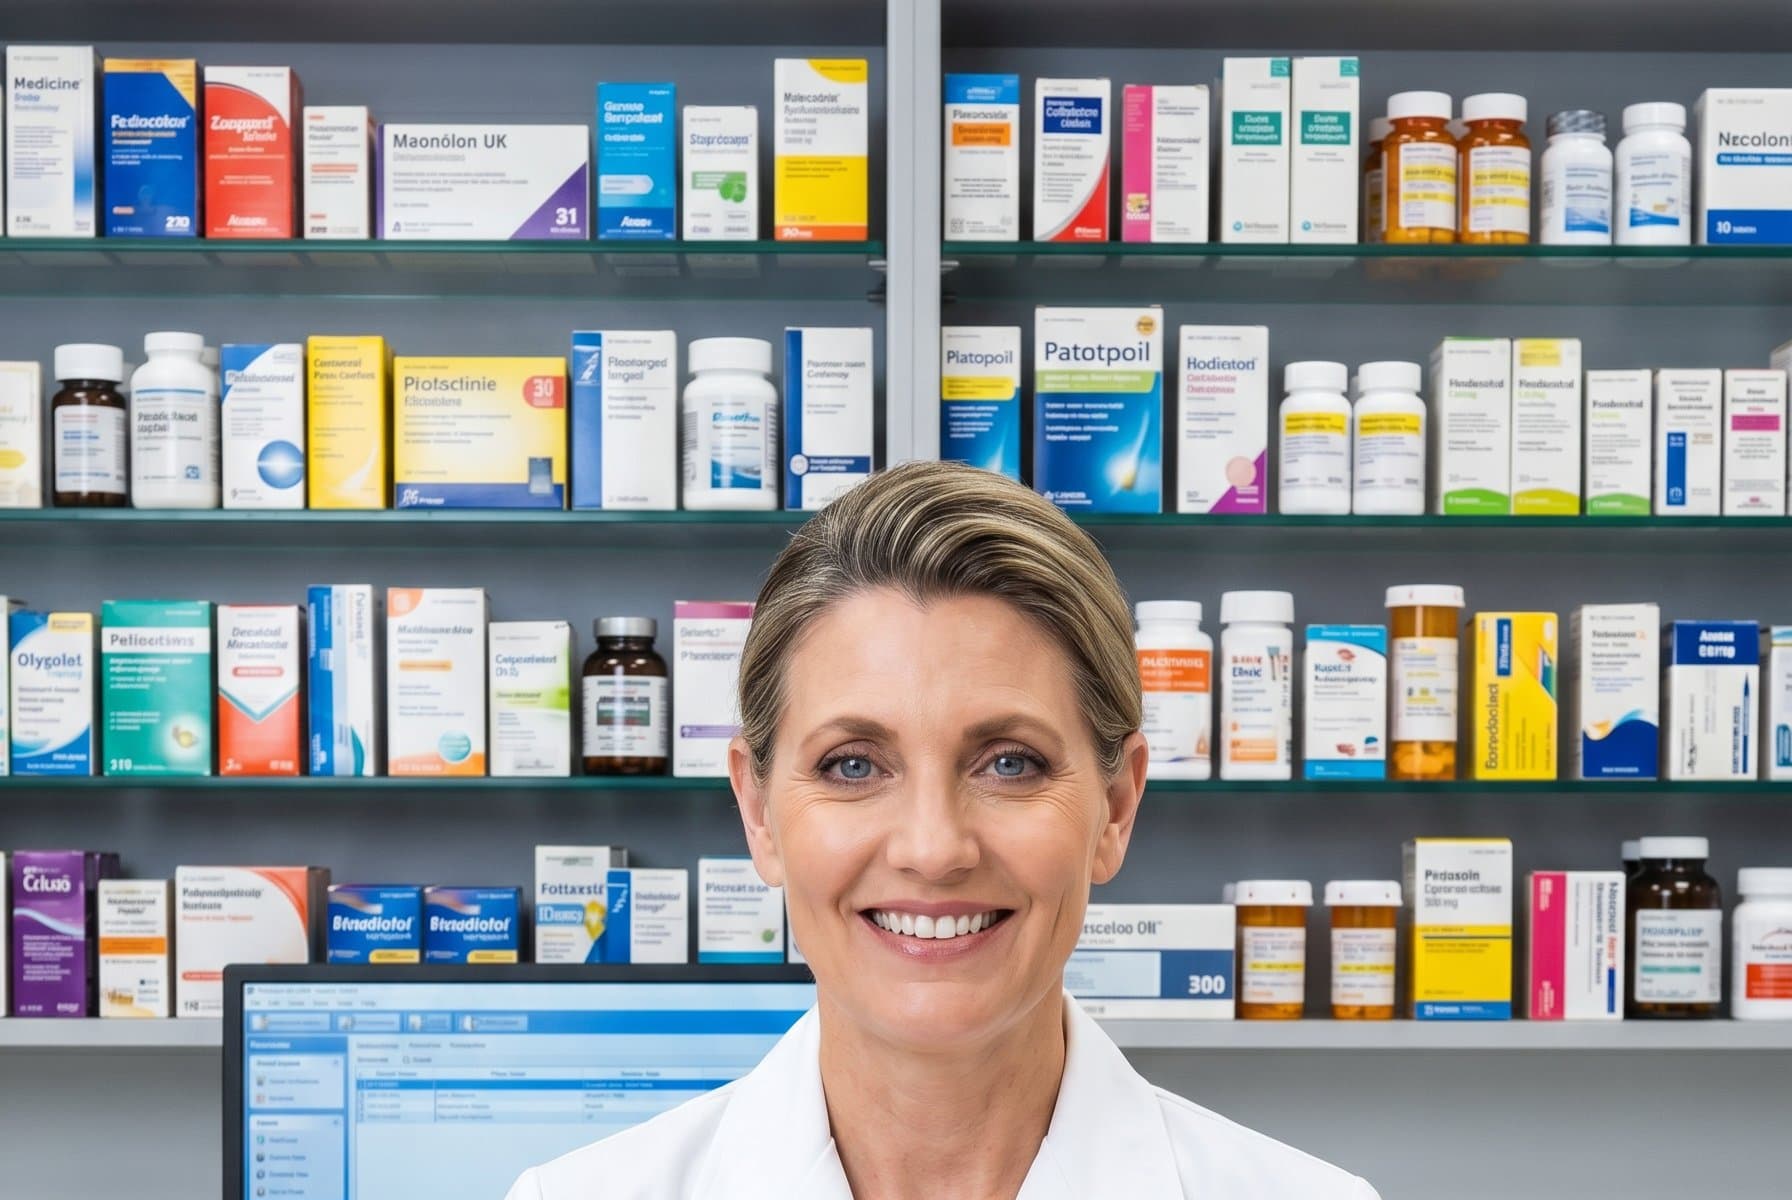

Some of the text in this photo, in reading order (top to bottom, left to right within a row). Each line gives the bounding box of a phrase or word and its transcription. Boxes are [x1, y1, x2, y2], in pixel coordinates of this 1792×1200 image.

[14, 77, 80, 90] Medicine
[484, 134, 508, 148] UK
[555, 208, 577, 225] 31
[947, 350, 1013, 367] Platopoil
[1045, 342, 1150, 366] Patotpoil
[533, 378, 554, 397] 30
[18, 653, 82, 669] Olygolet
[1189, 975, 1225, 994] 300
